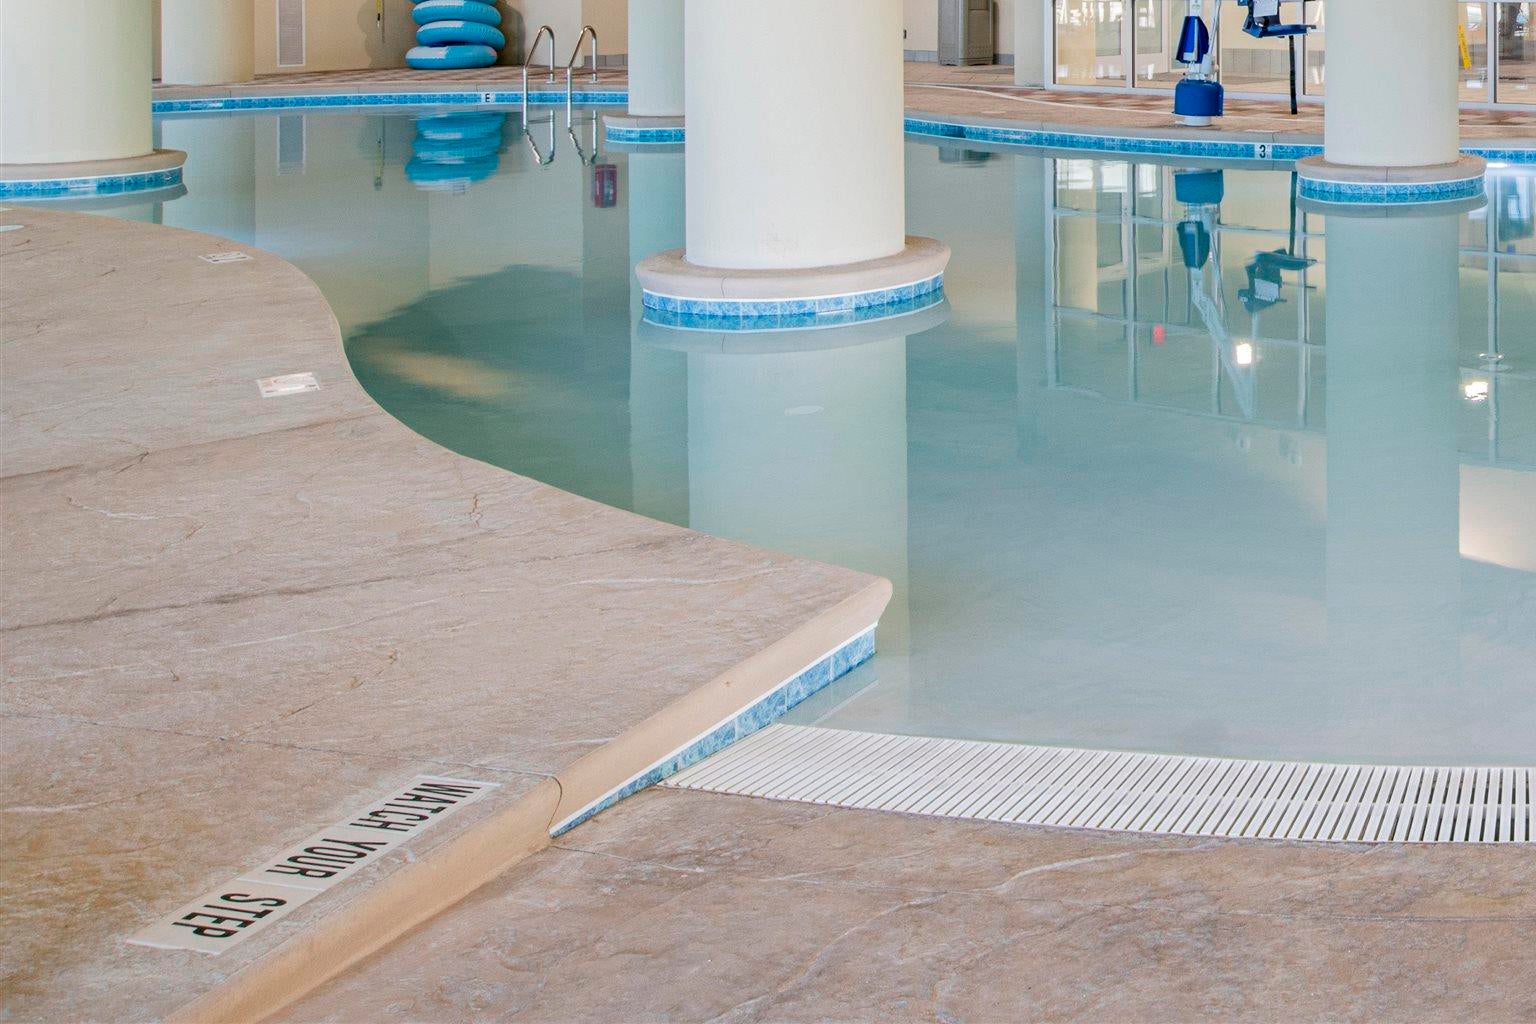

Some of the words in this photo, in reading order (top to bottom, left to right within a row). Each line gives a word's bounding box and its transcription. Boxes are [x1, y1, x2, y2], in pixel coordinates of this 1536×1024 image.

[349, 782, 482, 833] WATCH
[265, 837, 388, 879] YOUR
[171, 892, 288, 939] STEP
